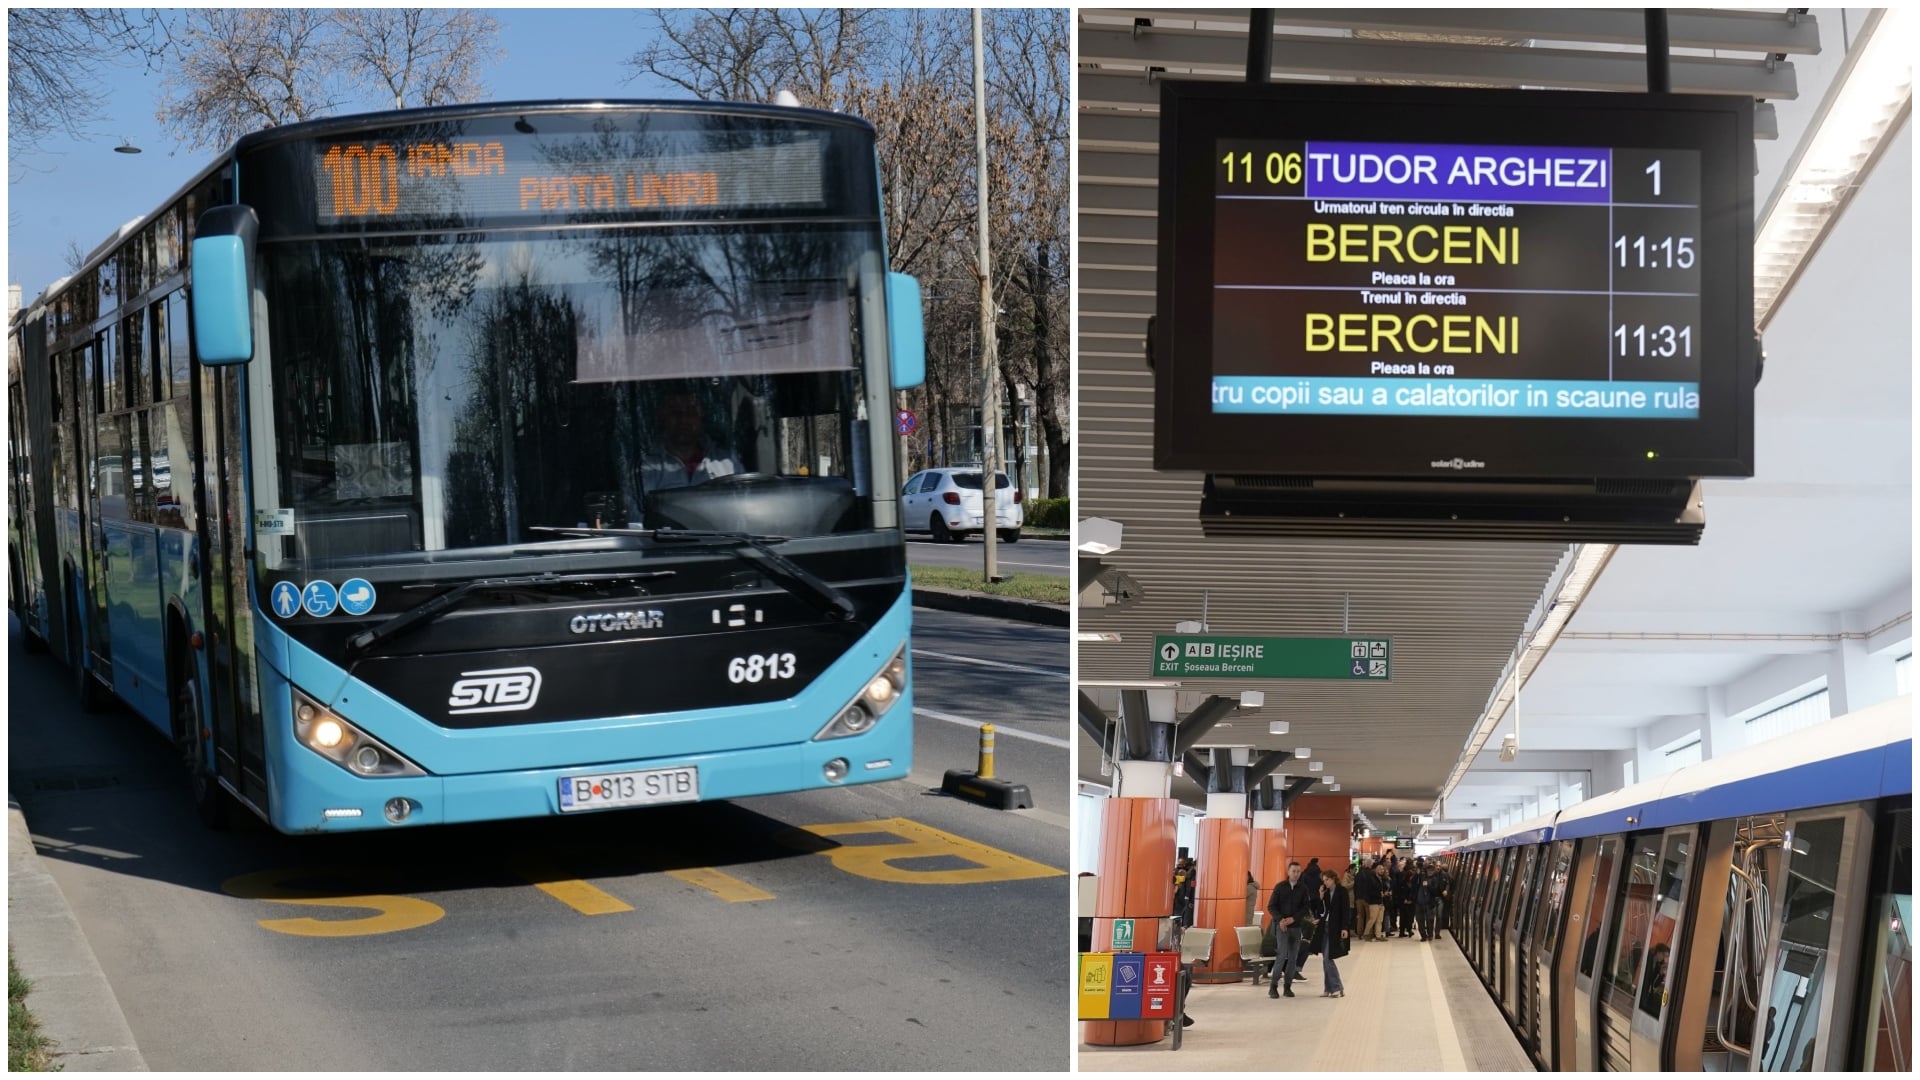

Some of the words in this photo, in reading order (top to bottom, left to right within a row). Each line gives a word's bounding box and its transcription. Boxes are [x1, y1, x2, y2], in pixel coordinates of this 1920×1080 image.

[323, 145, 398, 216] 100
[1222, 151, 1253, 183] 11
[1265, 152, 1302, 184] 06
[1309, 153, 1439, 185] TUDOR
[1447, 156, 1607, 188] ARGHEZI
[1645, 160, 1661, 196] 1
[519, 175, 615, 210] PIATA
[626, 172, 718, 208] UNIRII
[1313, 201, 1377, 215] Urmatorul
[1379, 202, 1405, 215] tren
[1407, 202, 1450, 216] circula
[1468, 203, 1515, 217] directia
[1306, 223, 1519, 265] BERCENI
[1614, 235, 1695, 269] 11:15
[1371, 271, 1417, 285] Pleaca
[1418, 272, 1432, 285] la
[1434, 274, 1456, 286] ora
[1361, 290, 1402, 304] Trenul
[1420, 291, 1467, 305] directia
[1305, 313, 1519, 354] BERCENI
[1614, 324, 1692, 358] 11:31
[1370, 361, 1416, 375] Pleaca
[1418, 362, 1431, 375] la
[1433, 364, 1455, 375] ora
[1212, 381, 1243, 404] tru
[1251, 382, 1311, 409] copii
[1317, 386, 1364, 405] sau
[1371, 387, 1389, 405] a
[1395, 383, 1519, 407] calatorilor
[1526, 384, 1548, 407] in
[1556, 389, 1647, 409] scaune
[1653, 386, 1699, 409] rula
[570, 610, 665, 634] OTOKAR
[728, 652, 797, 684] 6813
[1160, 662, 1179, 671] EXIT
[1184, 662, 1220, 673] Șoseaua
[1222, 663, 1254, 672] Berceni
[1188, 645, 1197, 655] A
[1204, 645, 1212, 655] B
[1218, 644, 1264, 661] IEȘIRE
[449, 673, 534, 708] STB
[576, 780, 592, 802] B
[601, 777, 635, 800] 813
[645, 771, 691, 796] STB
